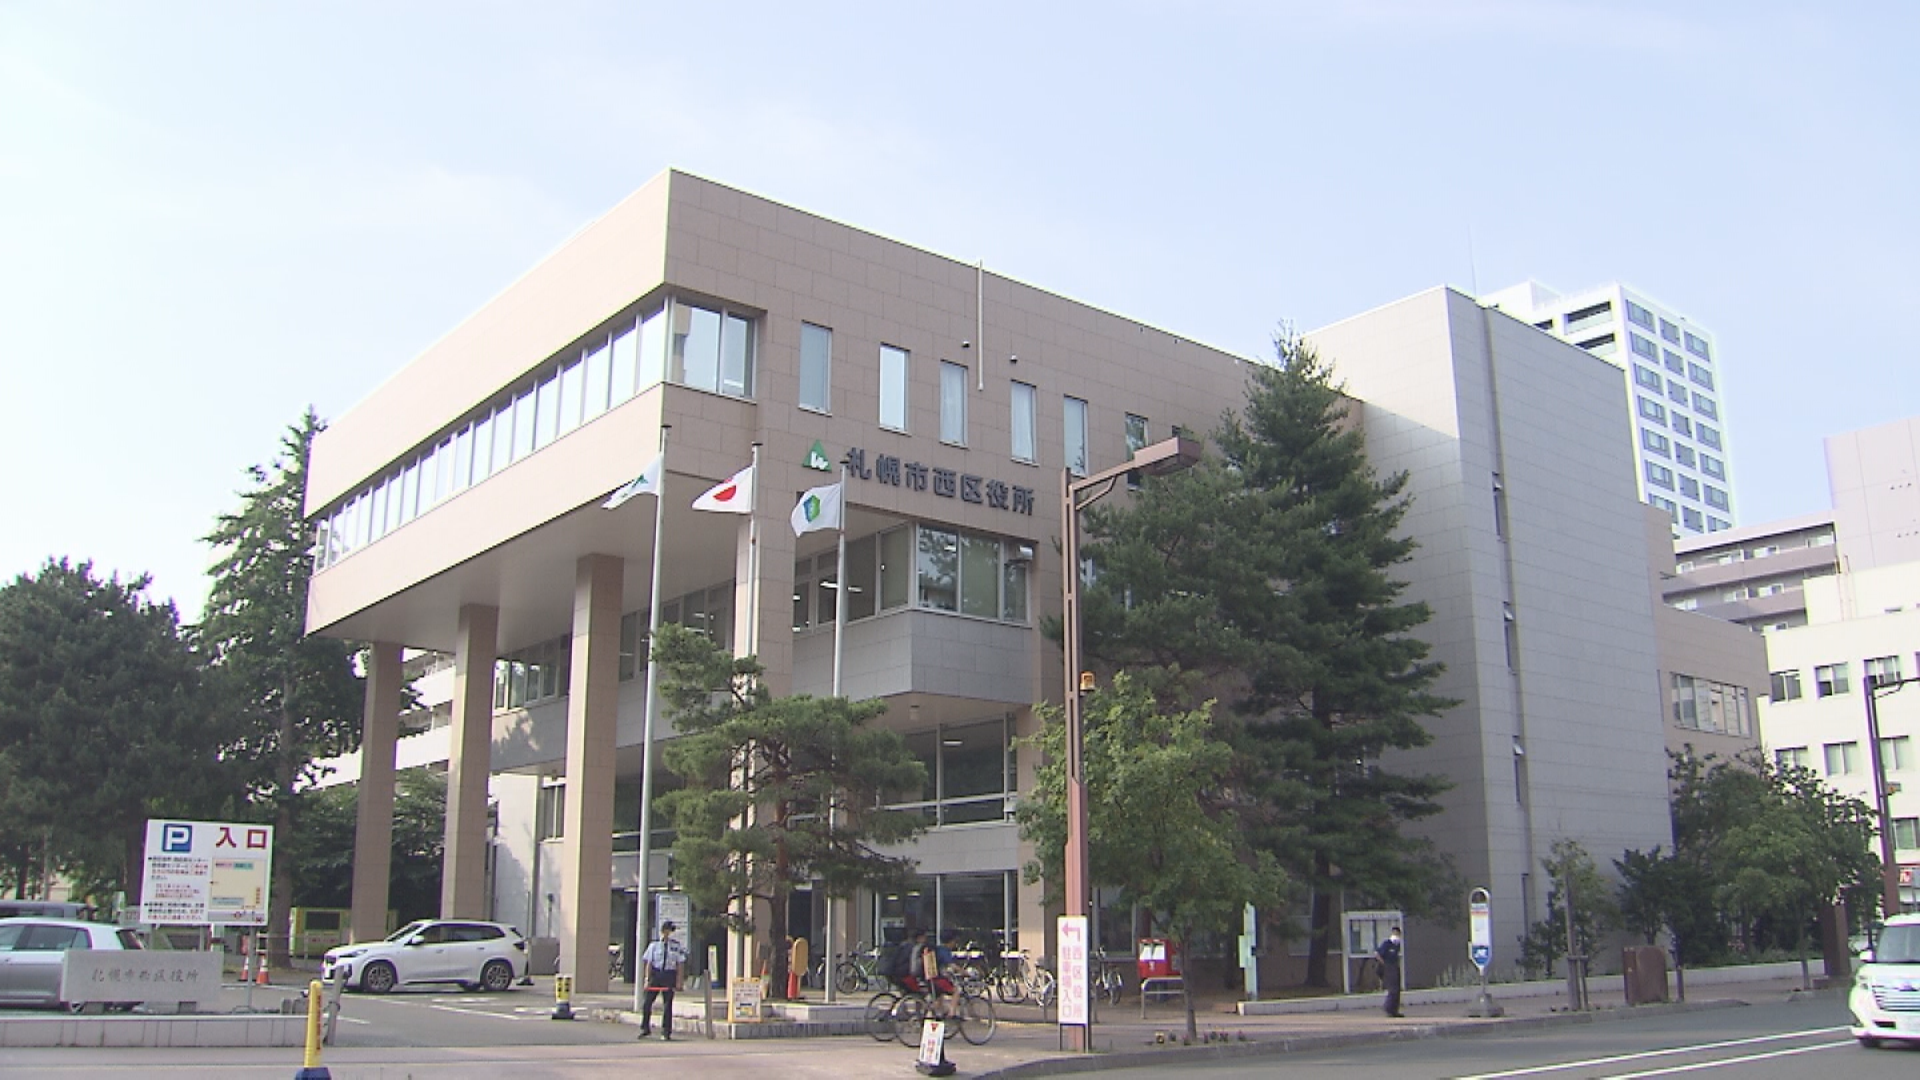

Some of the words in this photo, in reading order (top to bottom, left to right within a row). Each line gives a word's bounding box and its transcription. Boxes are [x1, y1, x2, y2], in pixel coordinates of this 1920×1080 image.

[847, 447, 1035, 516] 札幌市西区役所
[165, 826, 190, 851] P
[215, 826, 268, 850] 入口
